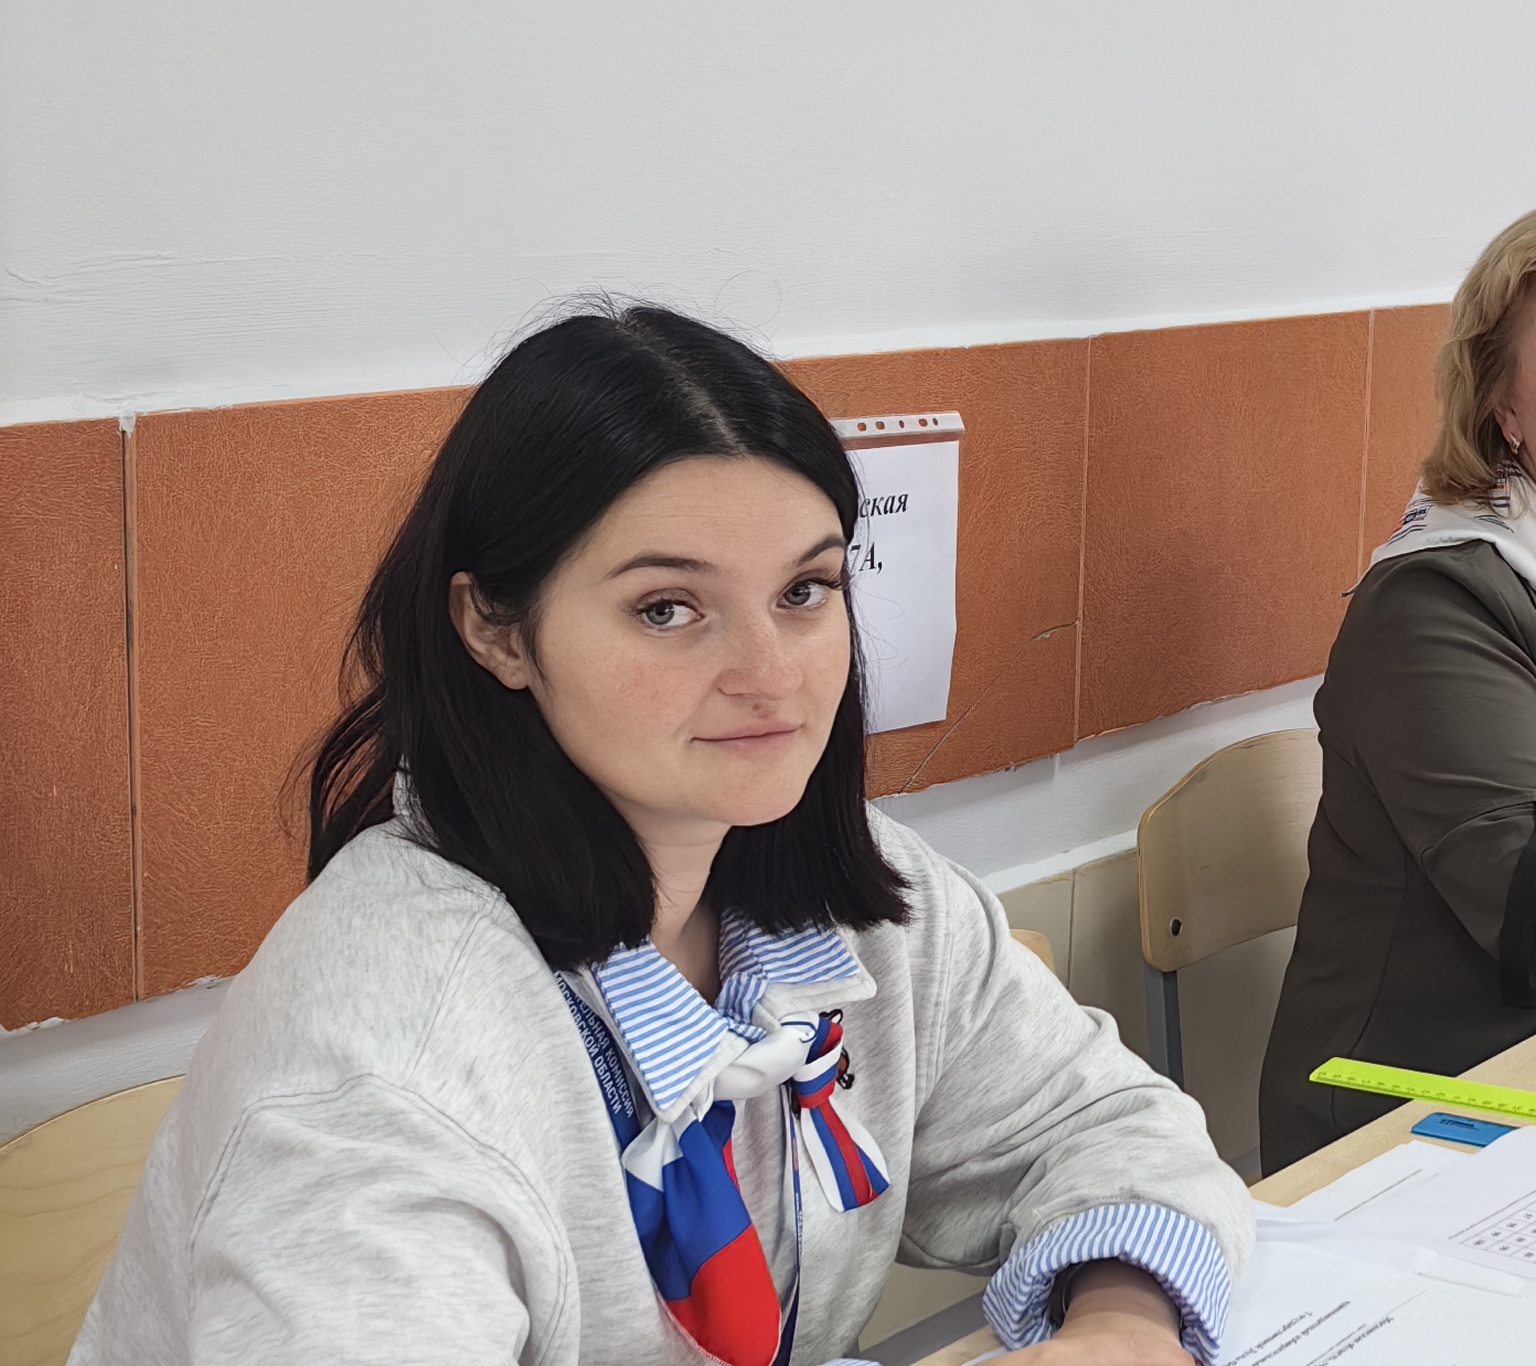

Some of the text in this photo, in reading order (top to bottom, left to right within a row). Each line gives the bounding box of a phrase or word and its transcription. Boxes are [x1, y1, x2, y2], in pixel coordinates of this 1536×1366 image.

[859, 492, 909, 518] ская
[594, 1055, 622, 1114] ОБЛАСТИ
[605, 1048, 634, 1118] КОМИССИЯ
